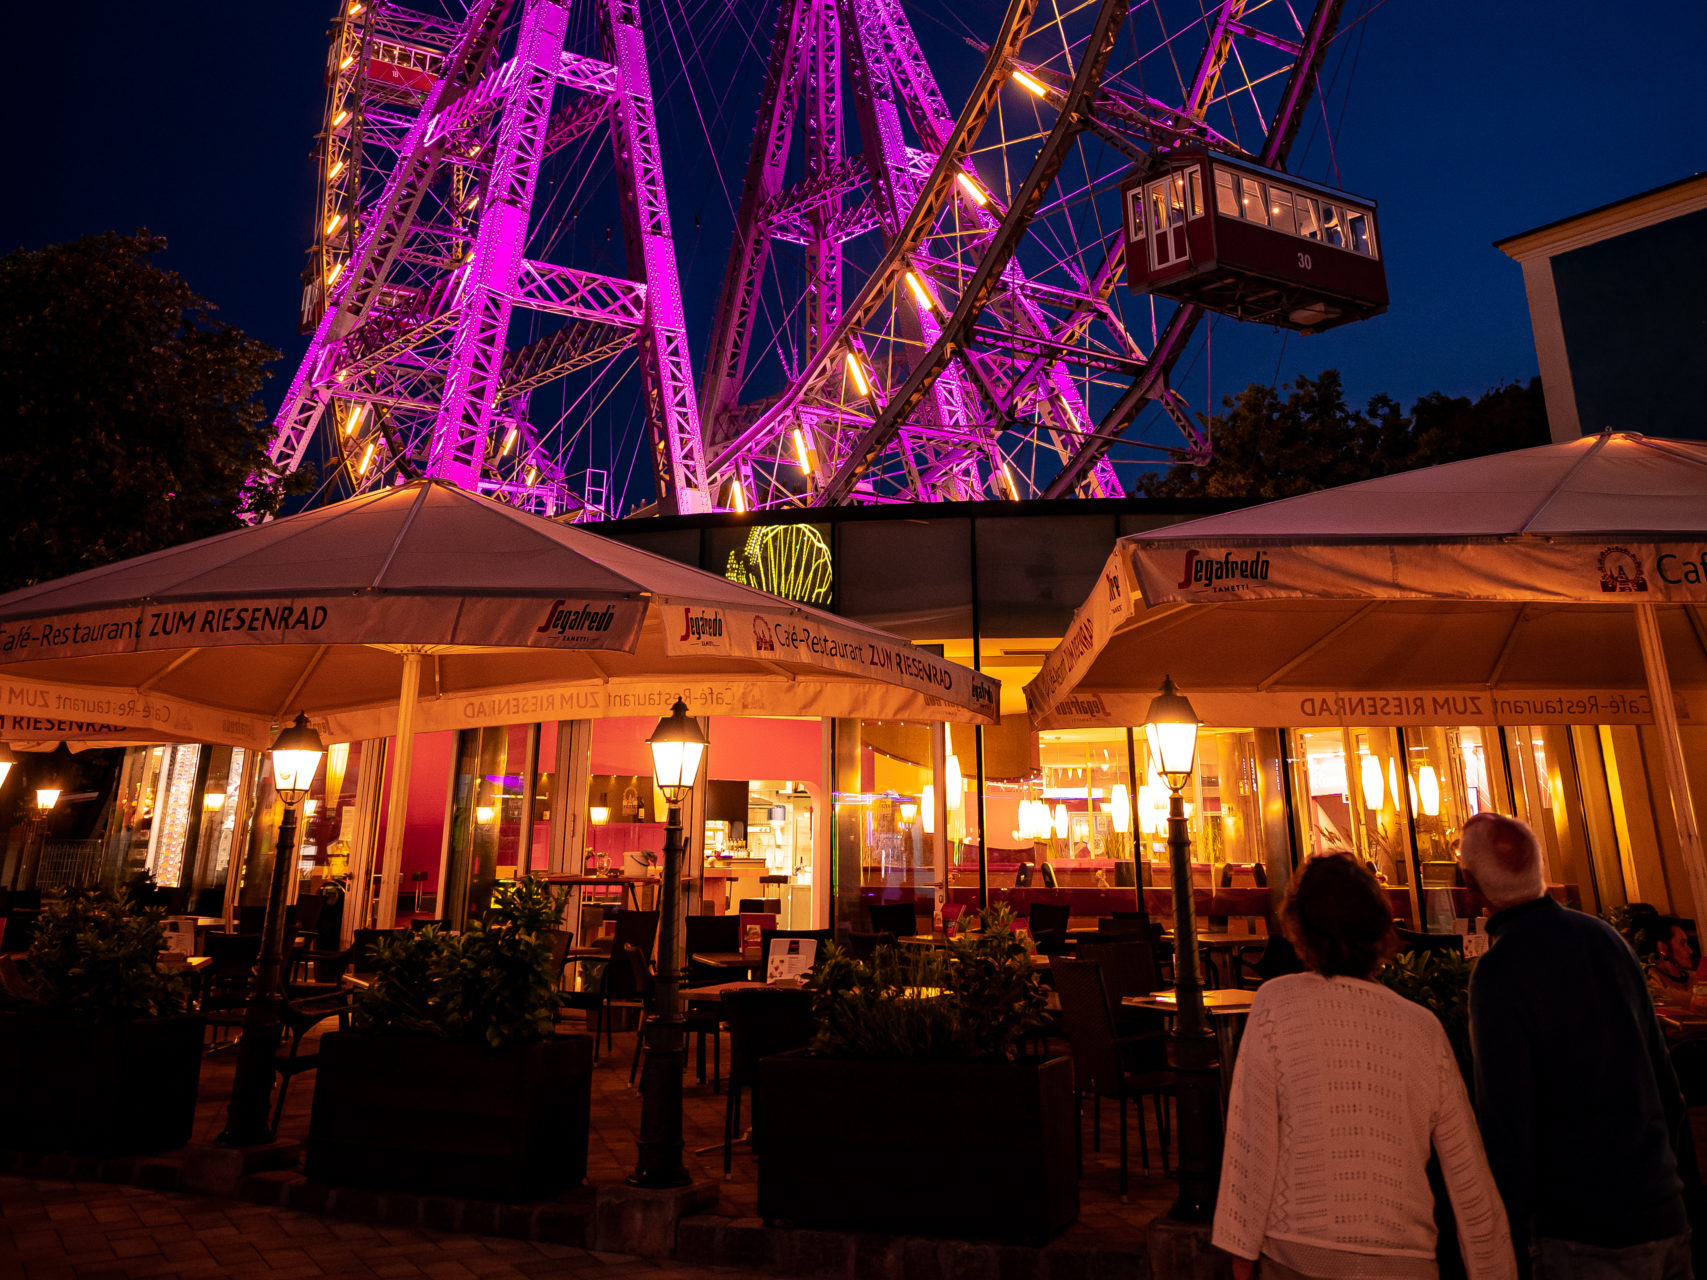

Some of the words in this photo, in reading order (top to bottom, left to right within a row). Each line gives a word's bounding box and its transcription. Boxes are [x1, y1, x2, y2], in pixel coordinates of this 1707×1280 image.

[1297, 252, 1312, 270] 30
[1178, 549, 1270, 588] Segafredo
[1212, 584, 1249, 593] ZANETTI
[149, 611, 197, 637] ZUM
[200, 606, 328, 632] RIESENRAD
[537, 599, 615, 634] Segafredo
[868, 643, 893, 672] ZUM
[895, 652, 953, 691] RIESENRAD
